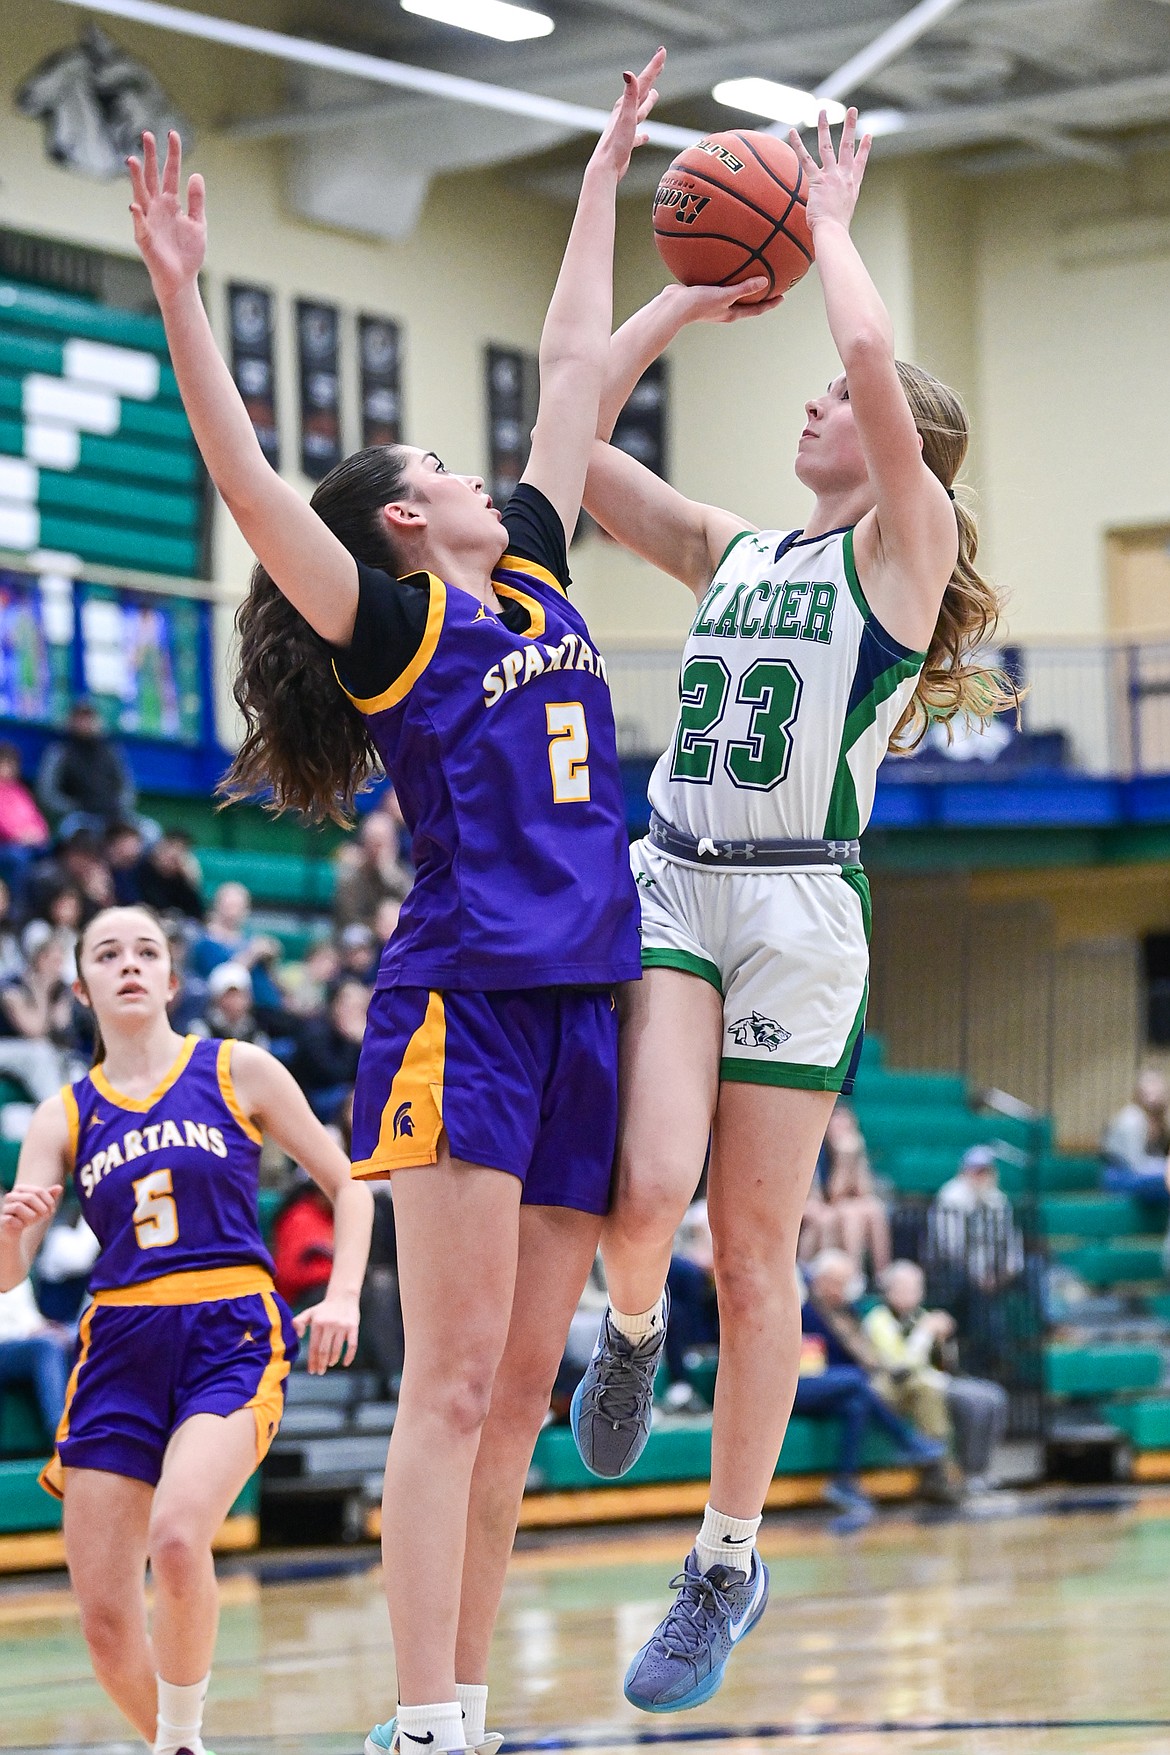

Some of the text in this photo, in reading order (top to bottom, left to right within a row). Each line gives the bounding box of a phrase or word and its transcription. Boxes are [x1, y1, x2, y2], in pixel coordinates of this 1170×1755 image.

[689, 580, 838, 645] LACIER
[547, 702, 590, 803] 2
[669, 655, 804, 793] 23
[81, 1120, 228, 1198] SPARTANS
[132, 1168, 179, 1249] 5
